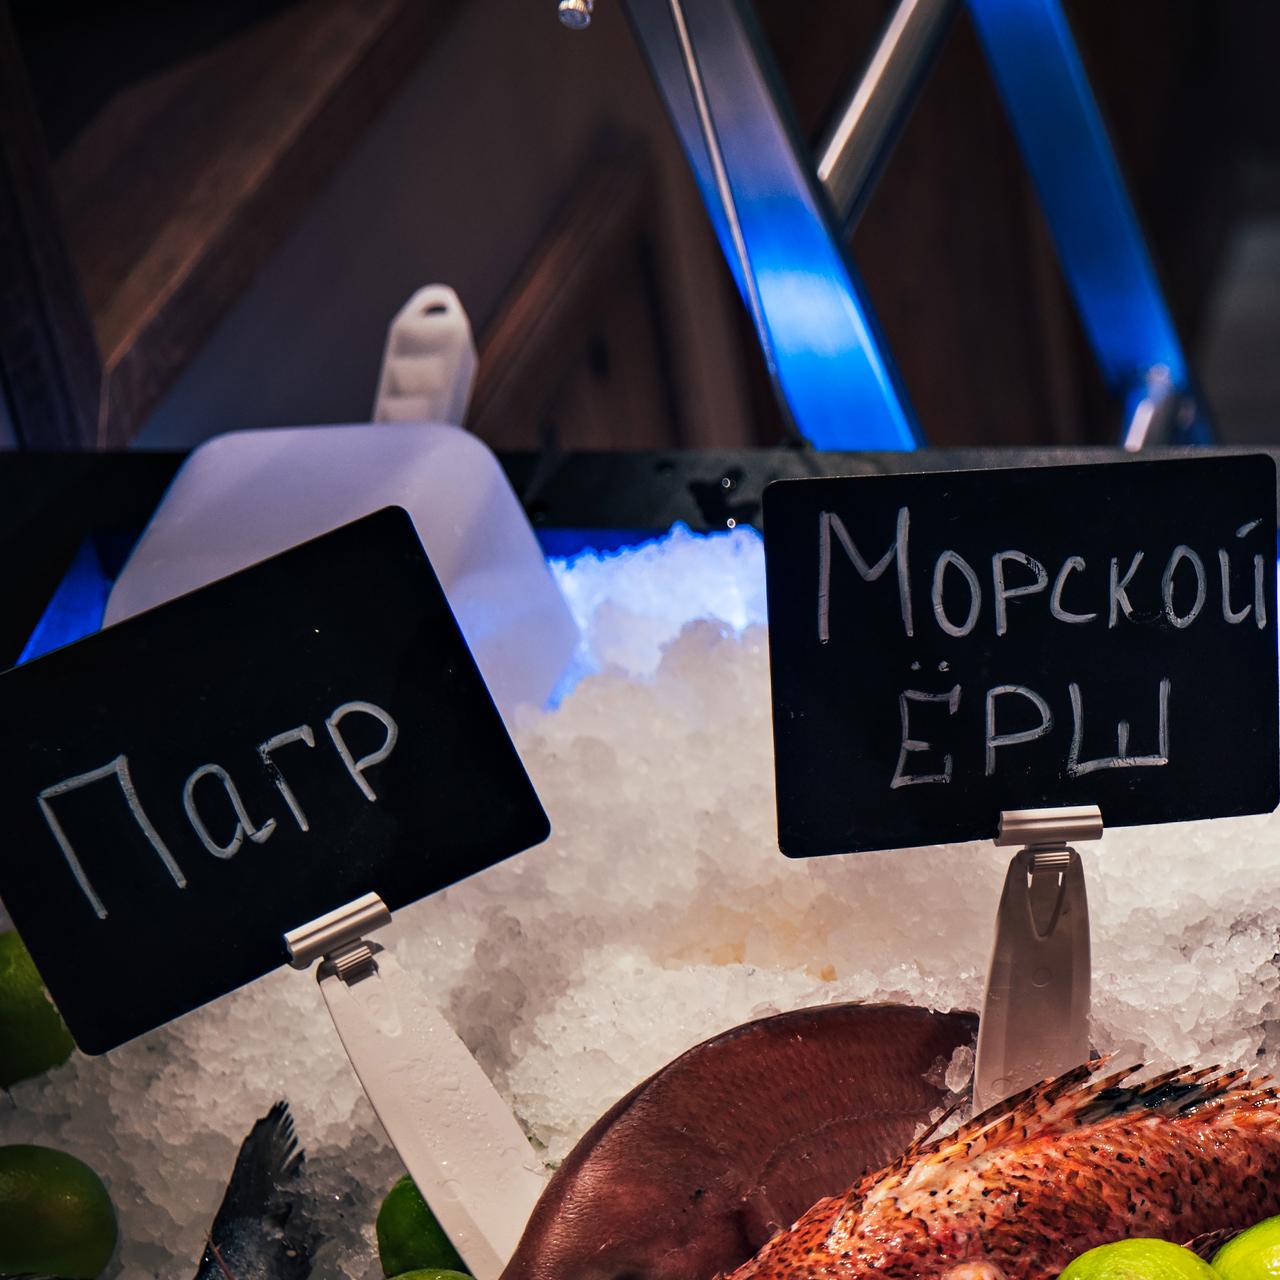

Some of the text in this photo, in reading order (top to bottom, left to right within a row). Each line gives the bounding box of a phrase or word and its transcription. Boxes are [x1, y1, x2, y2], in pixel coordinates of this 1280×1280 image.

[818, 505, 1267, 645] Морской
[889, 661, 1171, 790] ЁРШ
[37, 700, 399, 920] Пагр
